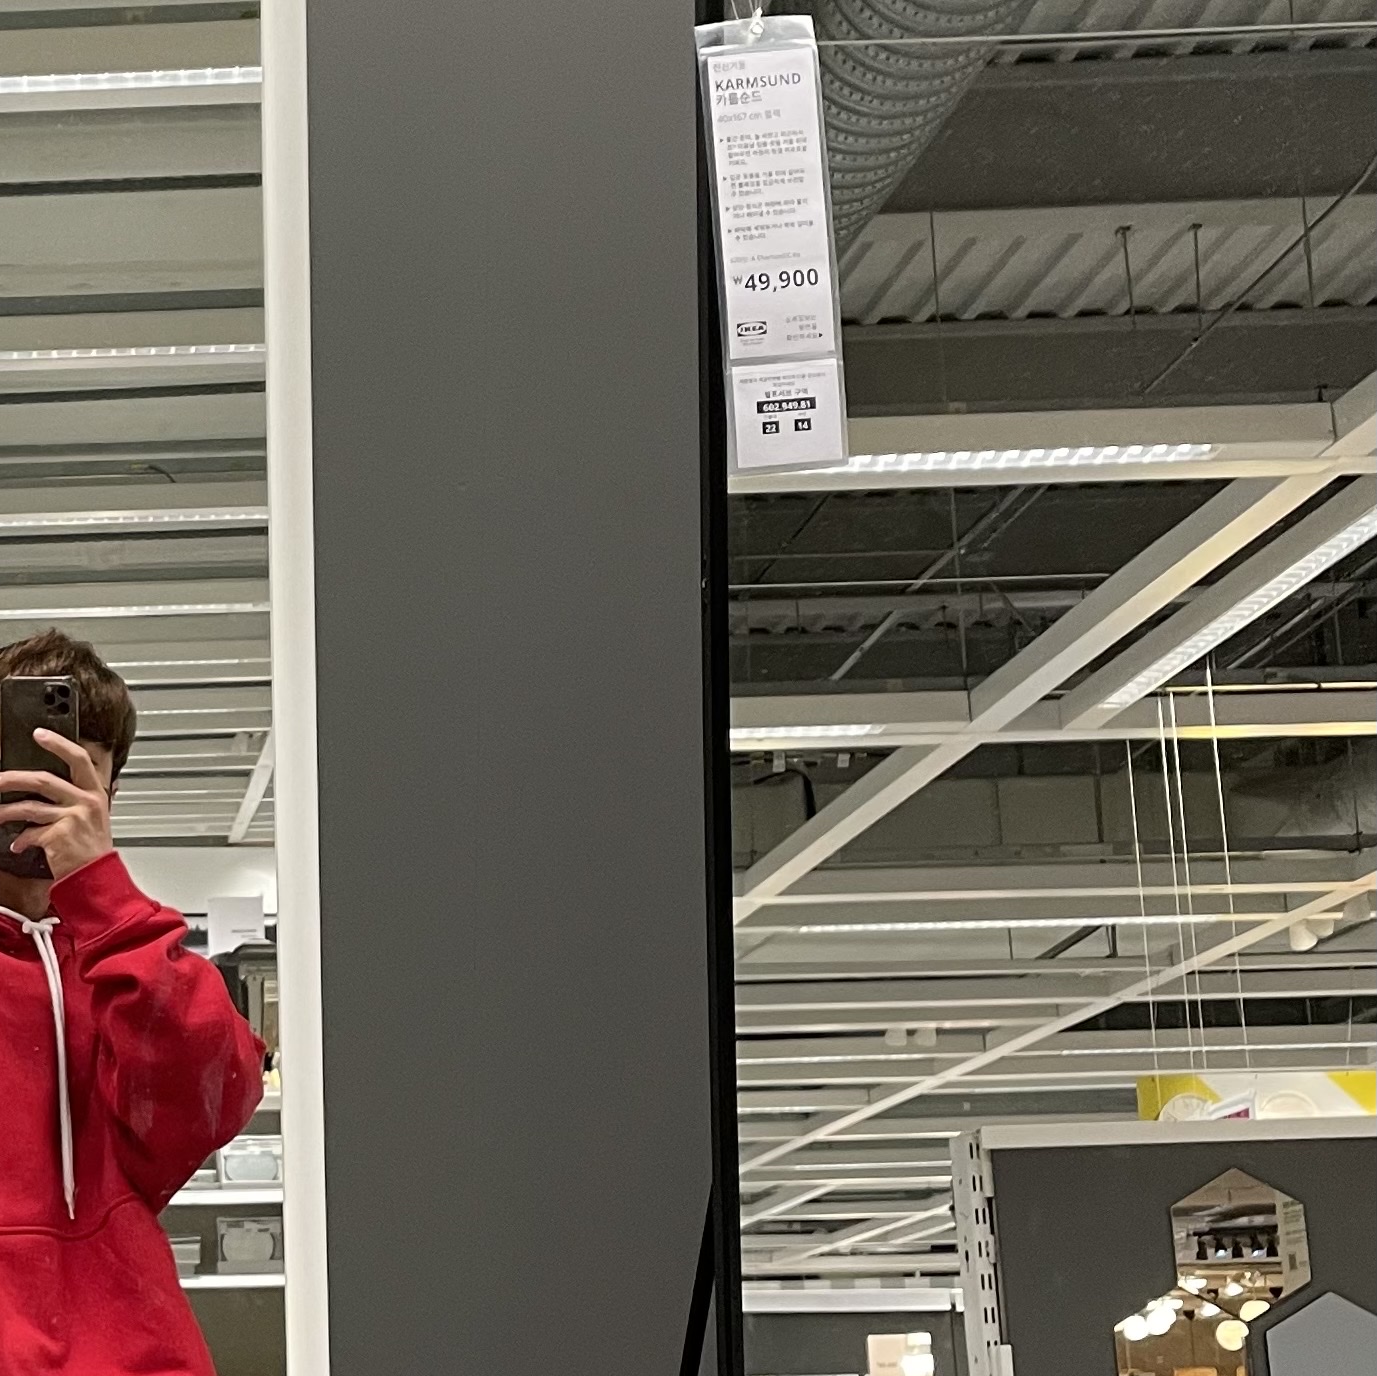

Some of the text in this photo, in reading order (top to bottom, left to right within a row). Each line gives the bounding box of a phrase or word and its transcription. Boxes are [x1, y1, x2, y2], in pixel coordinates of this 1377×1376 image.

[715, 72, 801, 93] KARMSUND
[762, 400, 811, 412] 602.949.81
[765, 424, 777, 433] 22
[797, 421, 809, 430] 14
